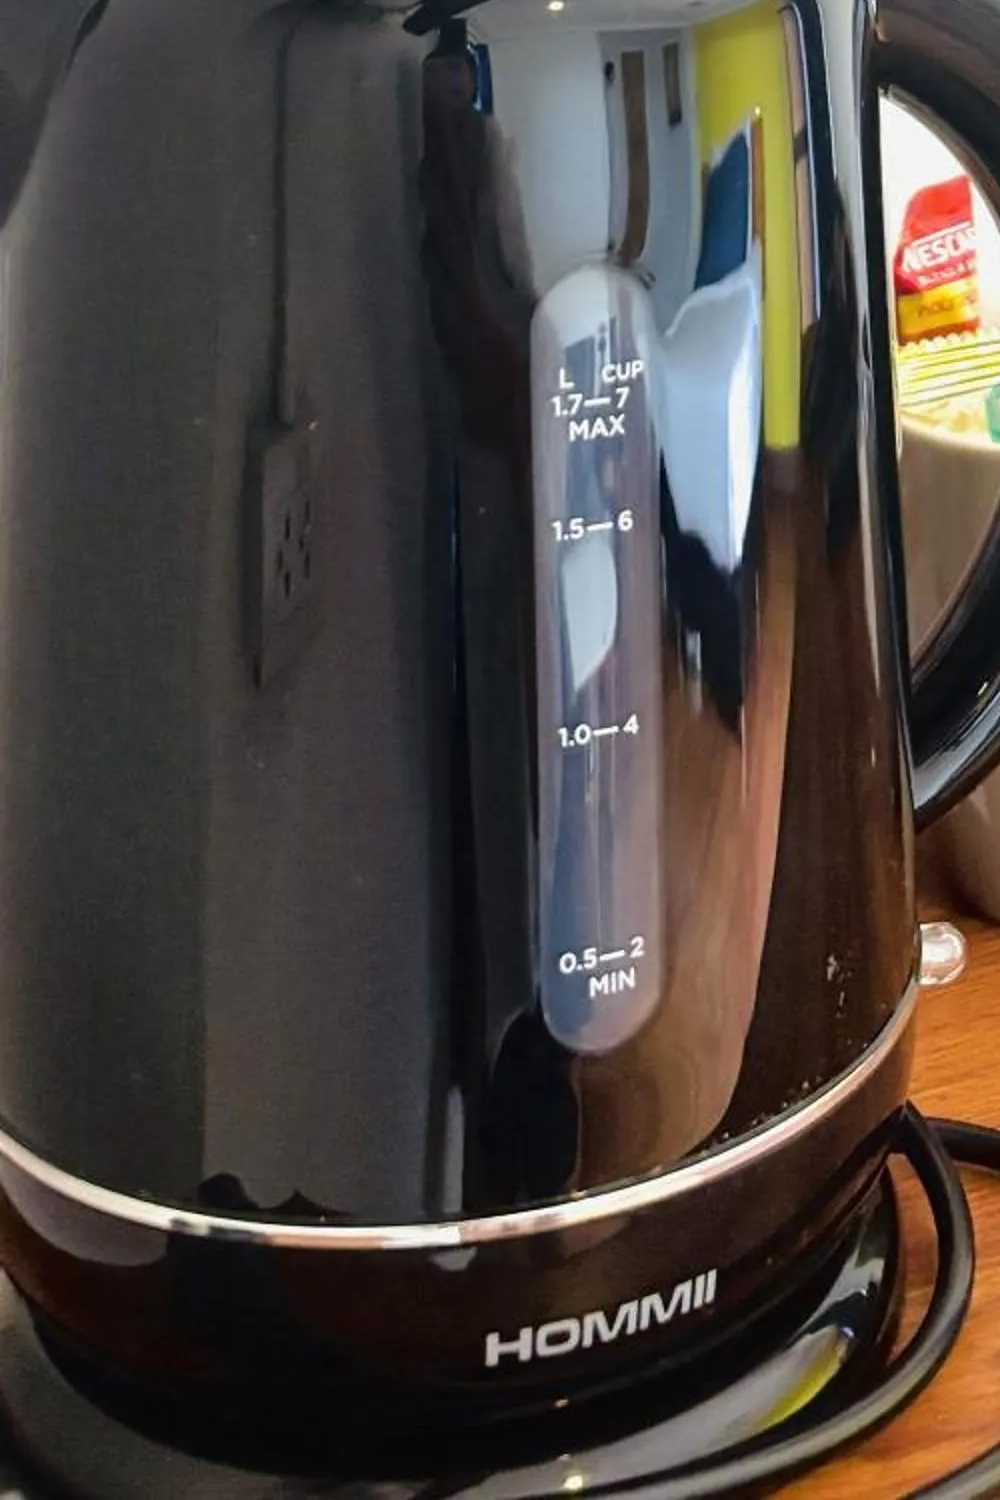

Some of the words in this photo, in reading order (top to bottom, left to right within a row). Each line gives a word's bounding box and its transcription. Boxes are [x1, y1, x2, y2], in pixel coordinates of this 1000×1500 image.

[558, 367, 576, 390] L
[601, 360, 645, 385] CUP
[568, 414, 625, 442] MAX
[588, 966, 637, 999] MIN
[484, 1267, 718, 1368] HOMMII
